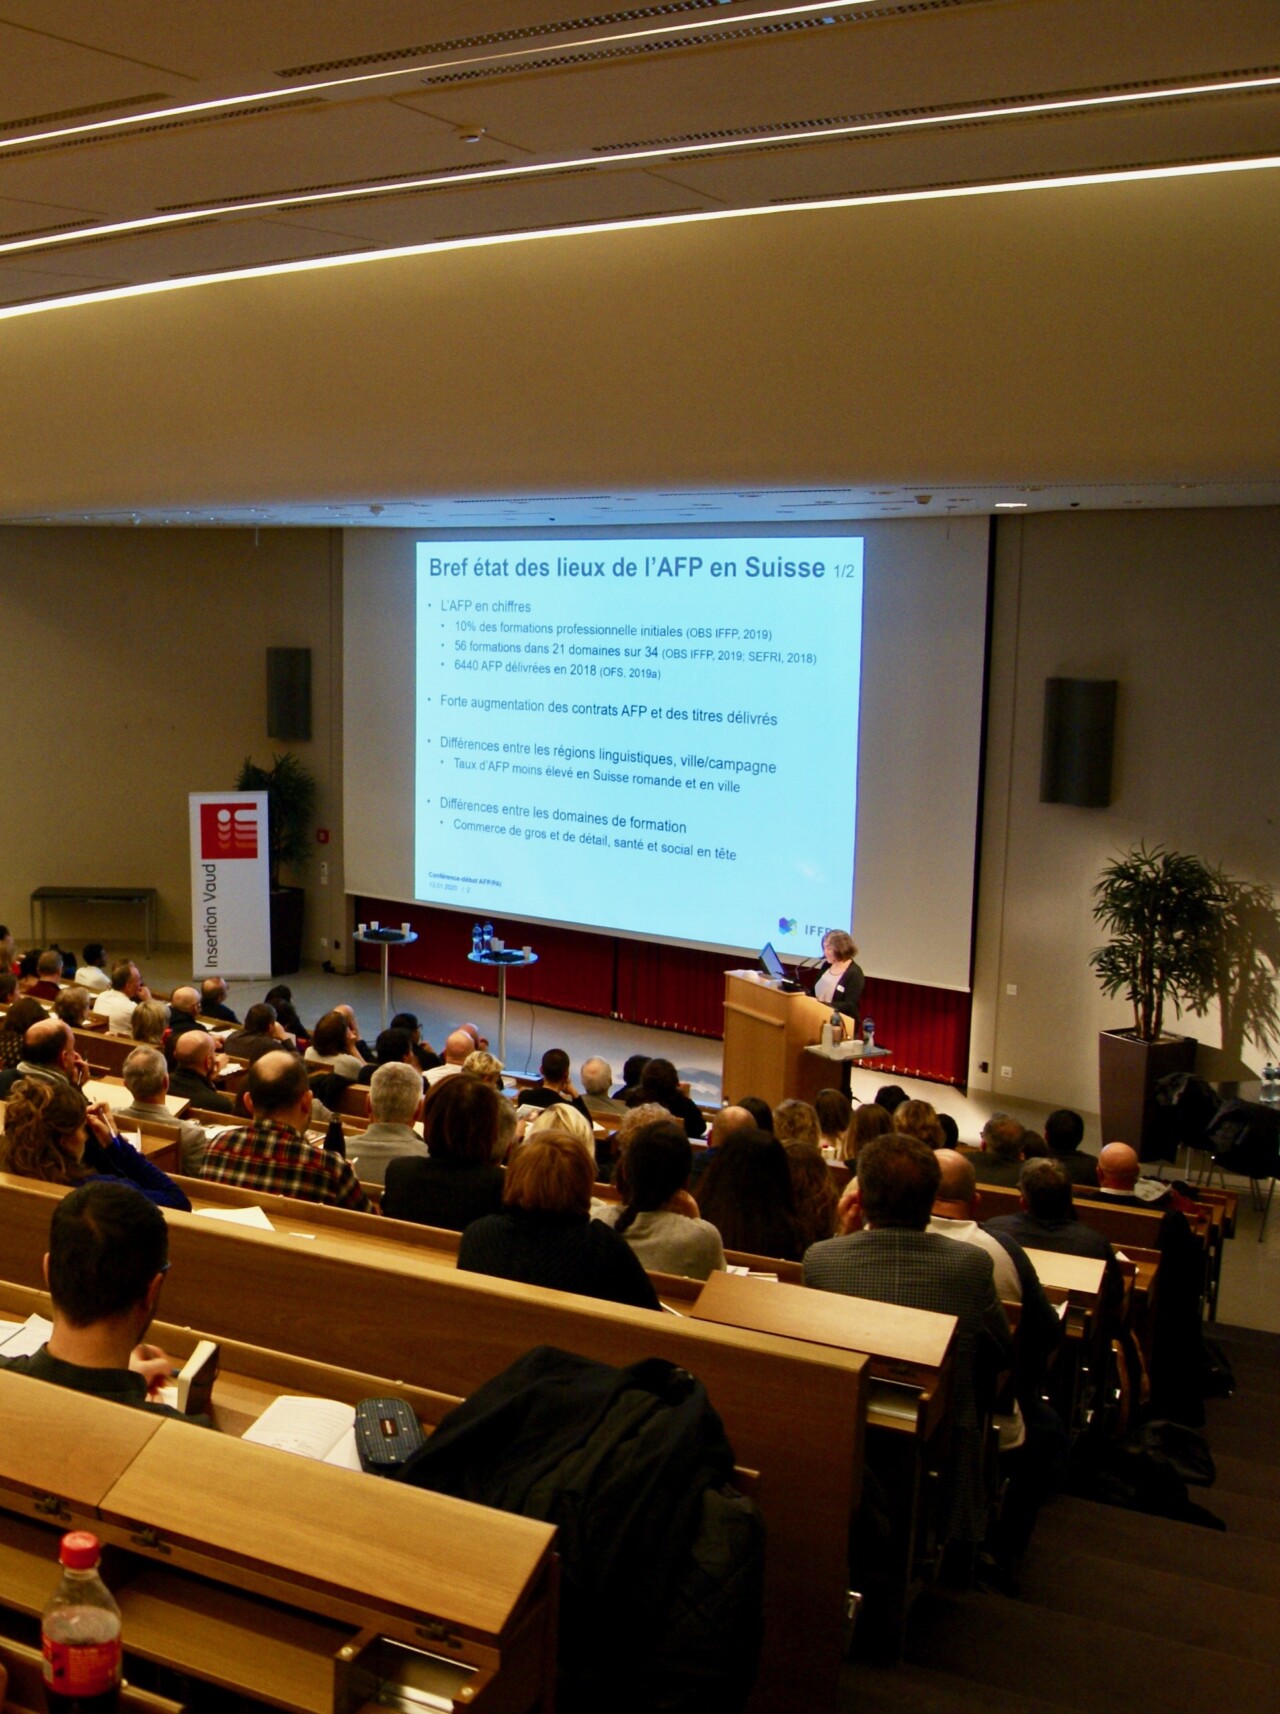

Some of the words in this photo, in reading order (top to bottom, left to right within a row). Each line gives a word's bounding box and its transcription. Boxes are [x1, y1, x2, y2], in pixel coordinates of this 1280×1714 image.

[430, 557, 468, 576] Bref
[474, 557, 509, 576] état
[515, 557, 550, 577] des
[558, 557, 605, 577] lieux
[612, 557, 637, 577] de
[646, 556, 703, 577] l’AFP
[710, 562, 736, 577] en
[745, 556, 826, 578] Suisse
[834, 564, 854, 578] 1/2
[475, 603, 488, 612] en
[492, 600, 531, 612] chiffres
[456, 620, 476, 631] 10%
[479, 622, 497, 632] des
[500, 622, 553, 634] formations
[556, 623, 637, 636] professionnelle
[641, 625, 683, 637] initiales
[686, 628, 712, 639] (OBS
[716, 628, 740, 640] IFFP,
[743, 629, 772, 642] 2019)
[455, 640, 467, 651] 56
[470, 640, 521, 653] formations
[524, 642, 549, 654] dans
[552, 643, 564, 654] 21
[569, 644, 620, 656] domaines
[624, 648, 642, 657] sur
[645, 646, 658, 658] 34
[662, 648, 688, 660] (OBS
[690, 649, 715, 661] IFFP,
[718, 650, 744, 662] 2019;
[748, 651, 784, 664] SEFRI,
[787, 652, 816, 665] 2018)
[454, 659, 478, 670] 6440
[481, 660, 502, 671] AFP
[505, 661, 551, 674] délivrées
[554, 666, 566, 674] en
[570, 664, 596, 676] 2018
[600, 667, 626, 678] (OFS,
[629, 668, 661, 680] 2019a)
[441, 694, 468, 707] Forte
[471, 699, 544, 712] augmentation
[548, 700, 568, 713] des
[572, 704, 618, 716] contrats
[621, 704, 647, 718] AFP
[651, 707, 662, 719] et
[666, 707, 688, 720] des
[692, 708, 723, 722] titres
[727, 710, 778, 726] délivrés
[440, 736, 499, 752] Différences
[503, 742, 530, 754] entre
[534, 743, 550, 756] les
[554, 744, 596, 760] régions
[599, 748, 676, 768] linguistiques,
[680, 754, 777, 775] ville/campagne
[454, 758, 476, 770] Taux
[512, 765, 542, 776] moins
[545, 765, 573, 778] élevé
[576, 770, 590, 779] en
[593, 769, 629, 783] Suisse
[632, 776, 682, 788] romande
[685, 778, 696, 789] et
[700, 781, 714, 790] en
[718, 780, 740, 792] ville
[440, 797, 498, 814] Différences
[502, 805, 530, 817] entre
[533, 806, 549, 819] les
[552, 809, 608, 826] domaines
[612, 814, 626, 827] de
[630, 816, 686, 834] formation
[454, 819, 506, 834] Commerce
[509, 825, 522, 836] de
[525, 829, 547, 840] gros
[550, 831, 560, 840] et
[562, 831, 576, 842] de
[579, 833, 610, 848] détail,
[614, 838, 644, 850] santé
[647, 842, 658, 852] et
[661, 844, 693, 856] social
[697, 848, 711, 858] en
[715, 848, 736, 860] tête
[202, 863, 216, 903] Vaud
[204, 906, 218, 968] Insertion
